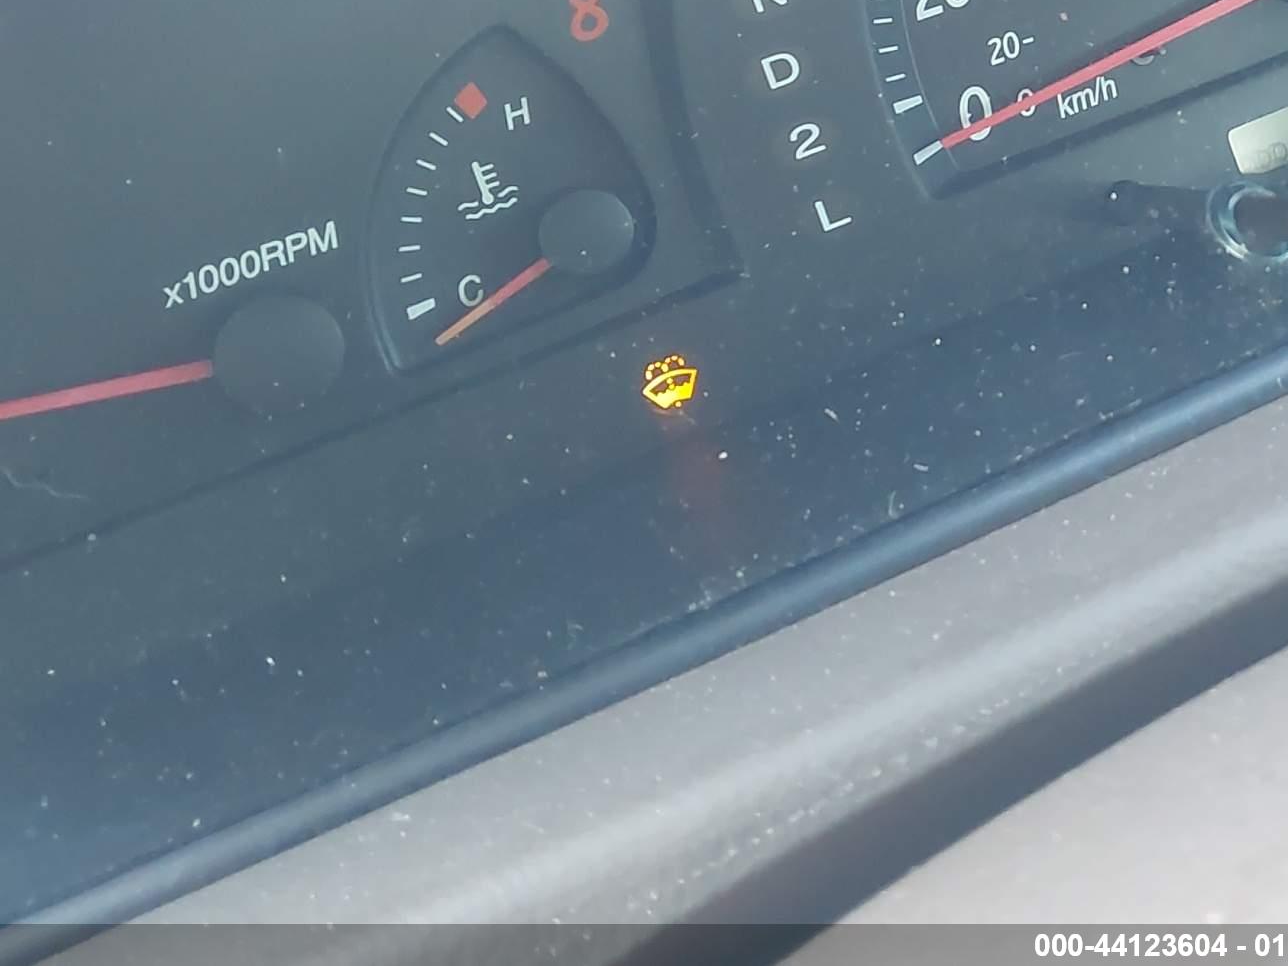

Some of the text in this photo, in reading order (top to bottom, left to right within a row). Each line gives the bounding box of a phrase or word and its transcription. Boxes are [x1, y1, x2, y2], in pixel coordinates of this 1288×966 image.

[987, 31, 1021, 65] 20
[761, 54, 801, 90] D
[505, 97, 531, 130] H
[1057, 76, 1118, 119] km/h
[790, 123, 828, 159] 2
[815, 200, 851, 232] L
[163, 221, 339, 309] x1000RPM
[459, 276, 484, 308] C
